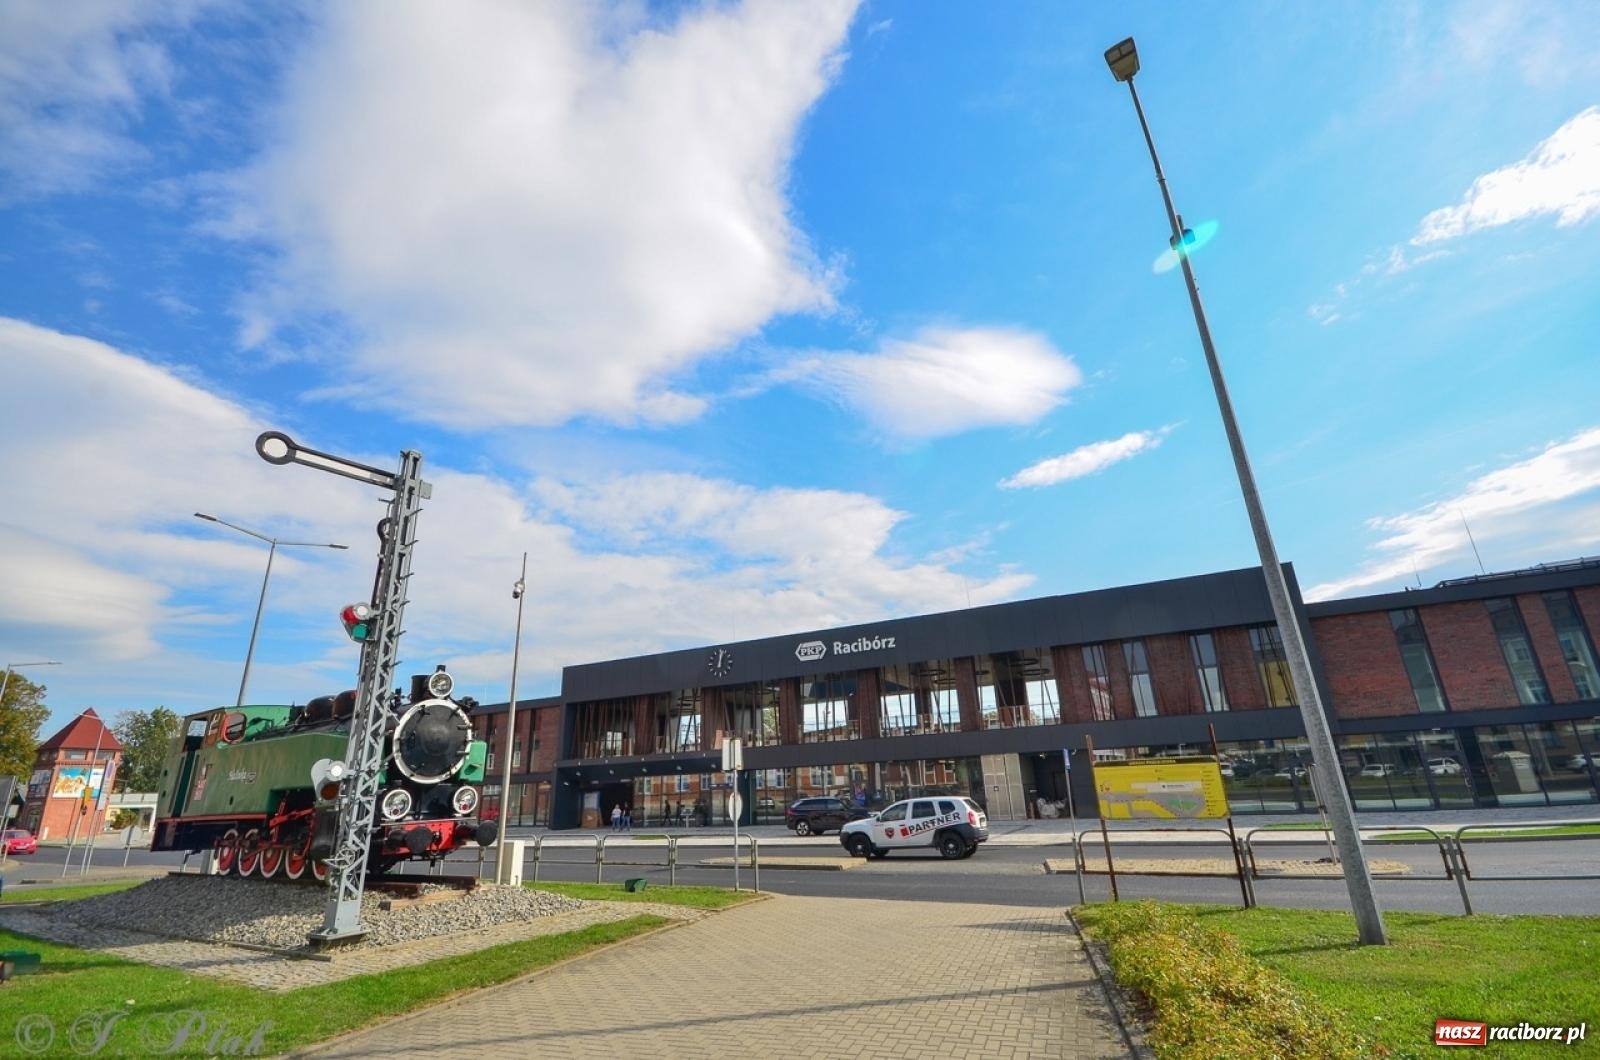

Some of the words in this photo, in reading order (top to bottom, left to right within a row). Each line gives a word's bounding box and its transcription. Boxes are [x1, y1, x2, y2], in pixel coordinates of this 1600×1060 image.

[800, 645, 823, 656] PKP
[833, 635, 896, 656] Racibórz
[909, 812, 961, 834] PARTNER
